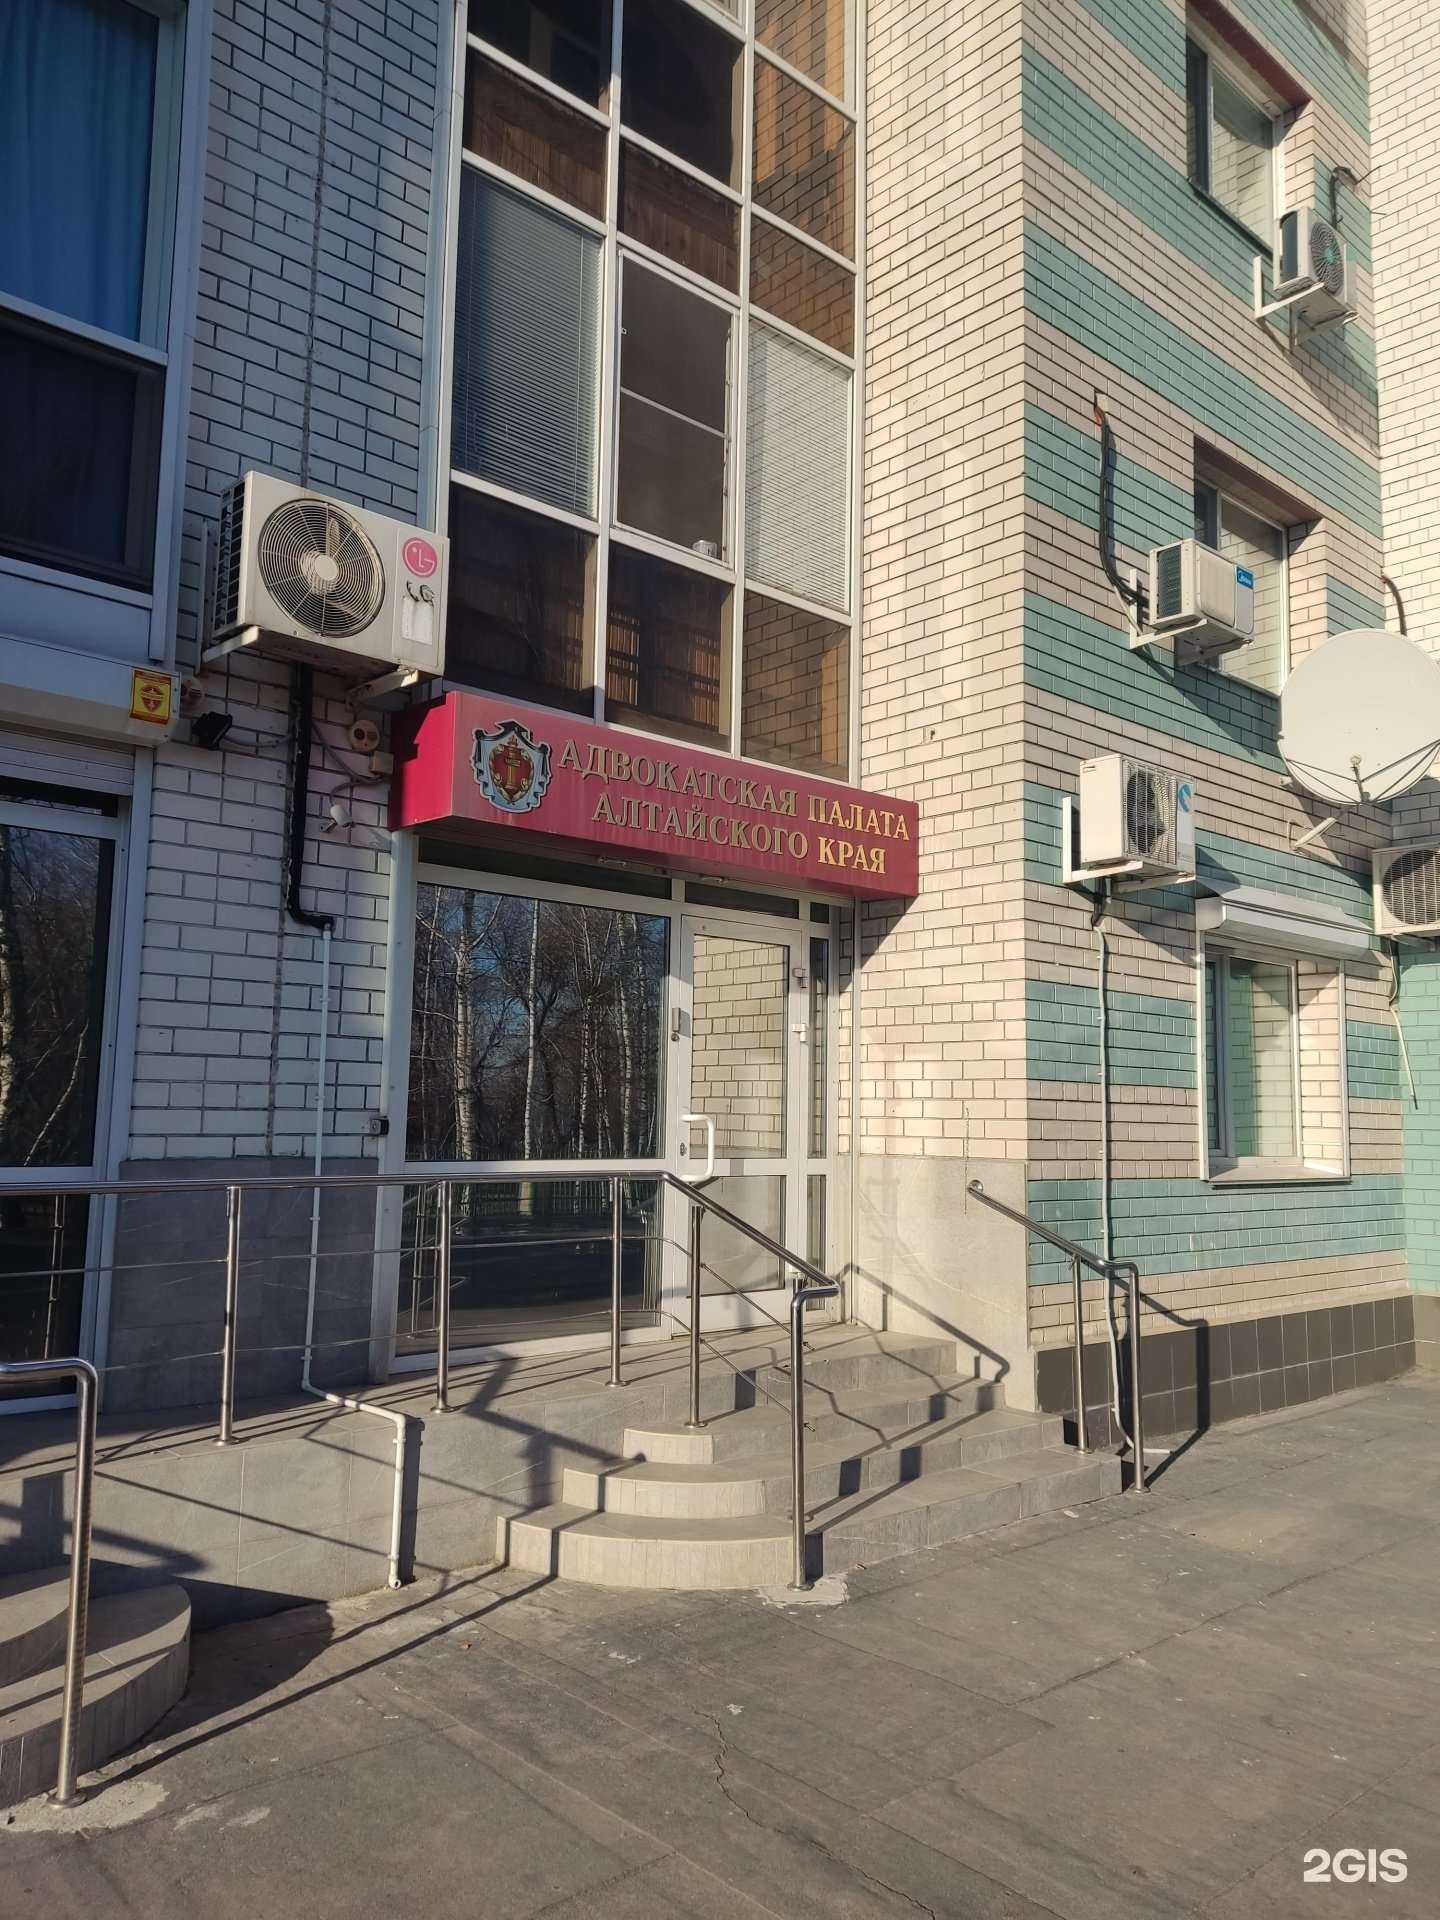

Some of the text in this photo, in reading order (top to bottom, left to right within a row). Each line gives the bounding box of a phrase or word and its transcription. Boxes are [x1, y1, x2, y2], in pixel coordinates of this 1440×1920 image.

[557, 738, 910, 840] АДВОКАТСКАЯ ПАЛАТА
[592, 793, 886, 873] АЛТАЙСКОГО КРАЯ
